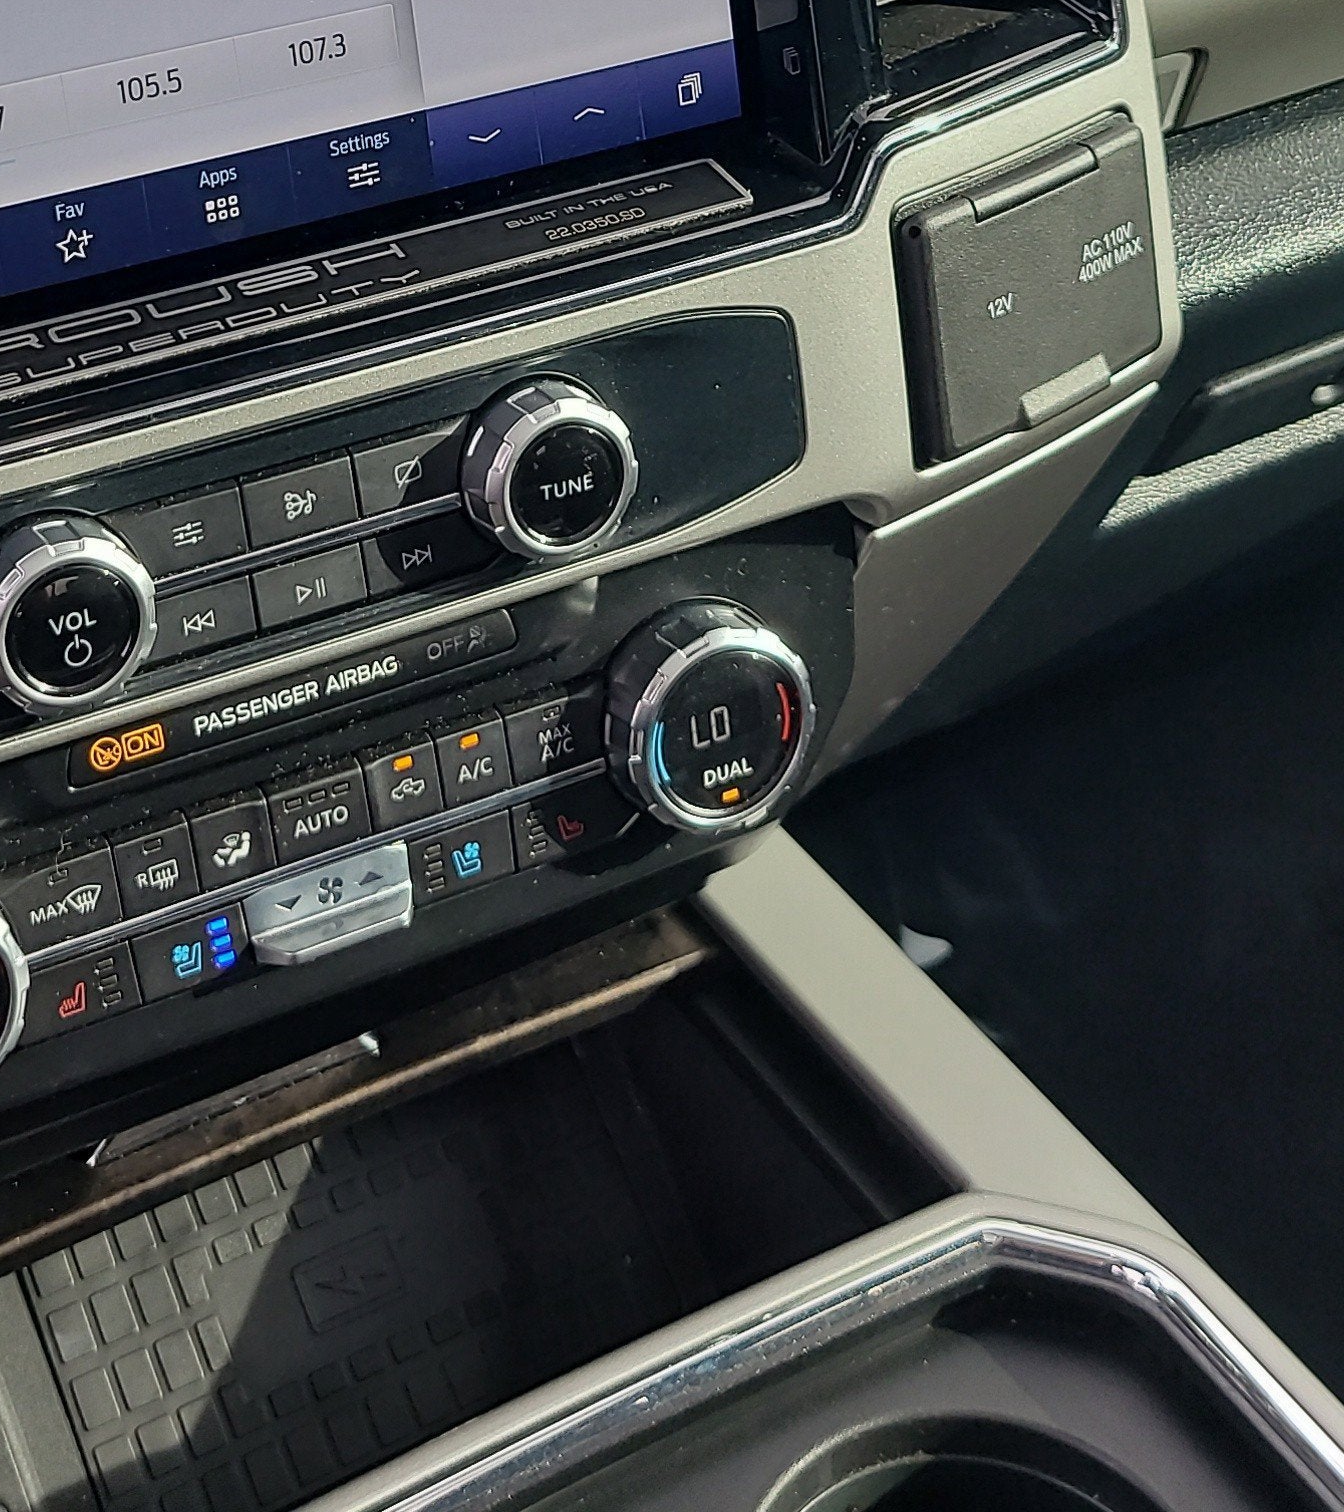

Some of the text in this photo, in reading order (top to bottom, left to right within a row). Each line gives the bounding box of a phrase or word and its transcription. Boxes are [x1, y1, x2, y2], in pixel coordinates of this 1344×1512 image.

[288, 34, 347, 66] 107.3
[117, 69, 183, 105] 105.5
[329, 129, 390, 158] Settings
[198, 164, 237, 190] Apps
[55, 199, 85, 221] Fav
[505, 181, 674, 230] BUILT IN THE USA
[1082, 221, 1134, 262] AC 110V
[1078, 237, 1144, 283] 400W MAX
[987, 292, 1015, 319] 12V
[539, 474, 594, 501] TUNE
[49, 609, 96, 635] VOL
[426, 635, 463, 661] OFF
[193, 655, 398, 737] PASSENGER AIRBAG
[127, 730, 160, 754] ON
[539, 723, 571, 745] MAX
[541, 737, 574, 762] A/C
[458, 756, 493, 784] A/C
[702, 757, 754, 788] DUAL
[292, 804, 349, 840] AUTO
[30, 899, 69, 927] MAX
